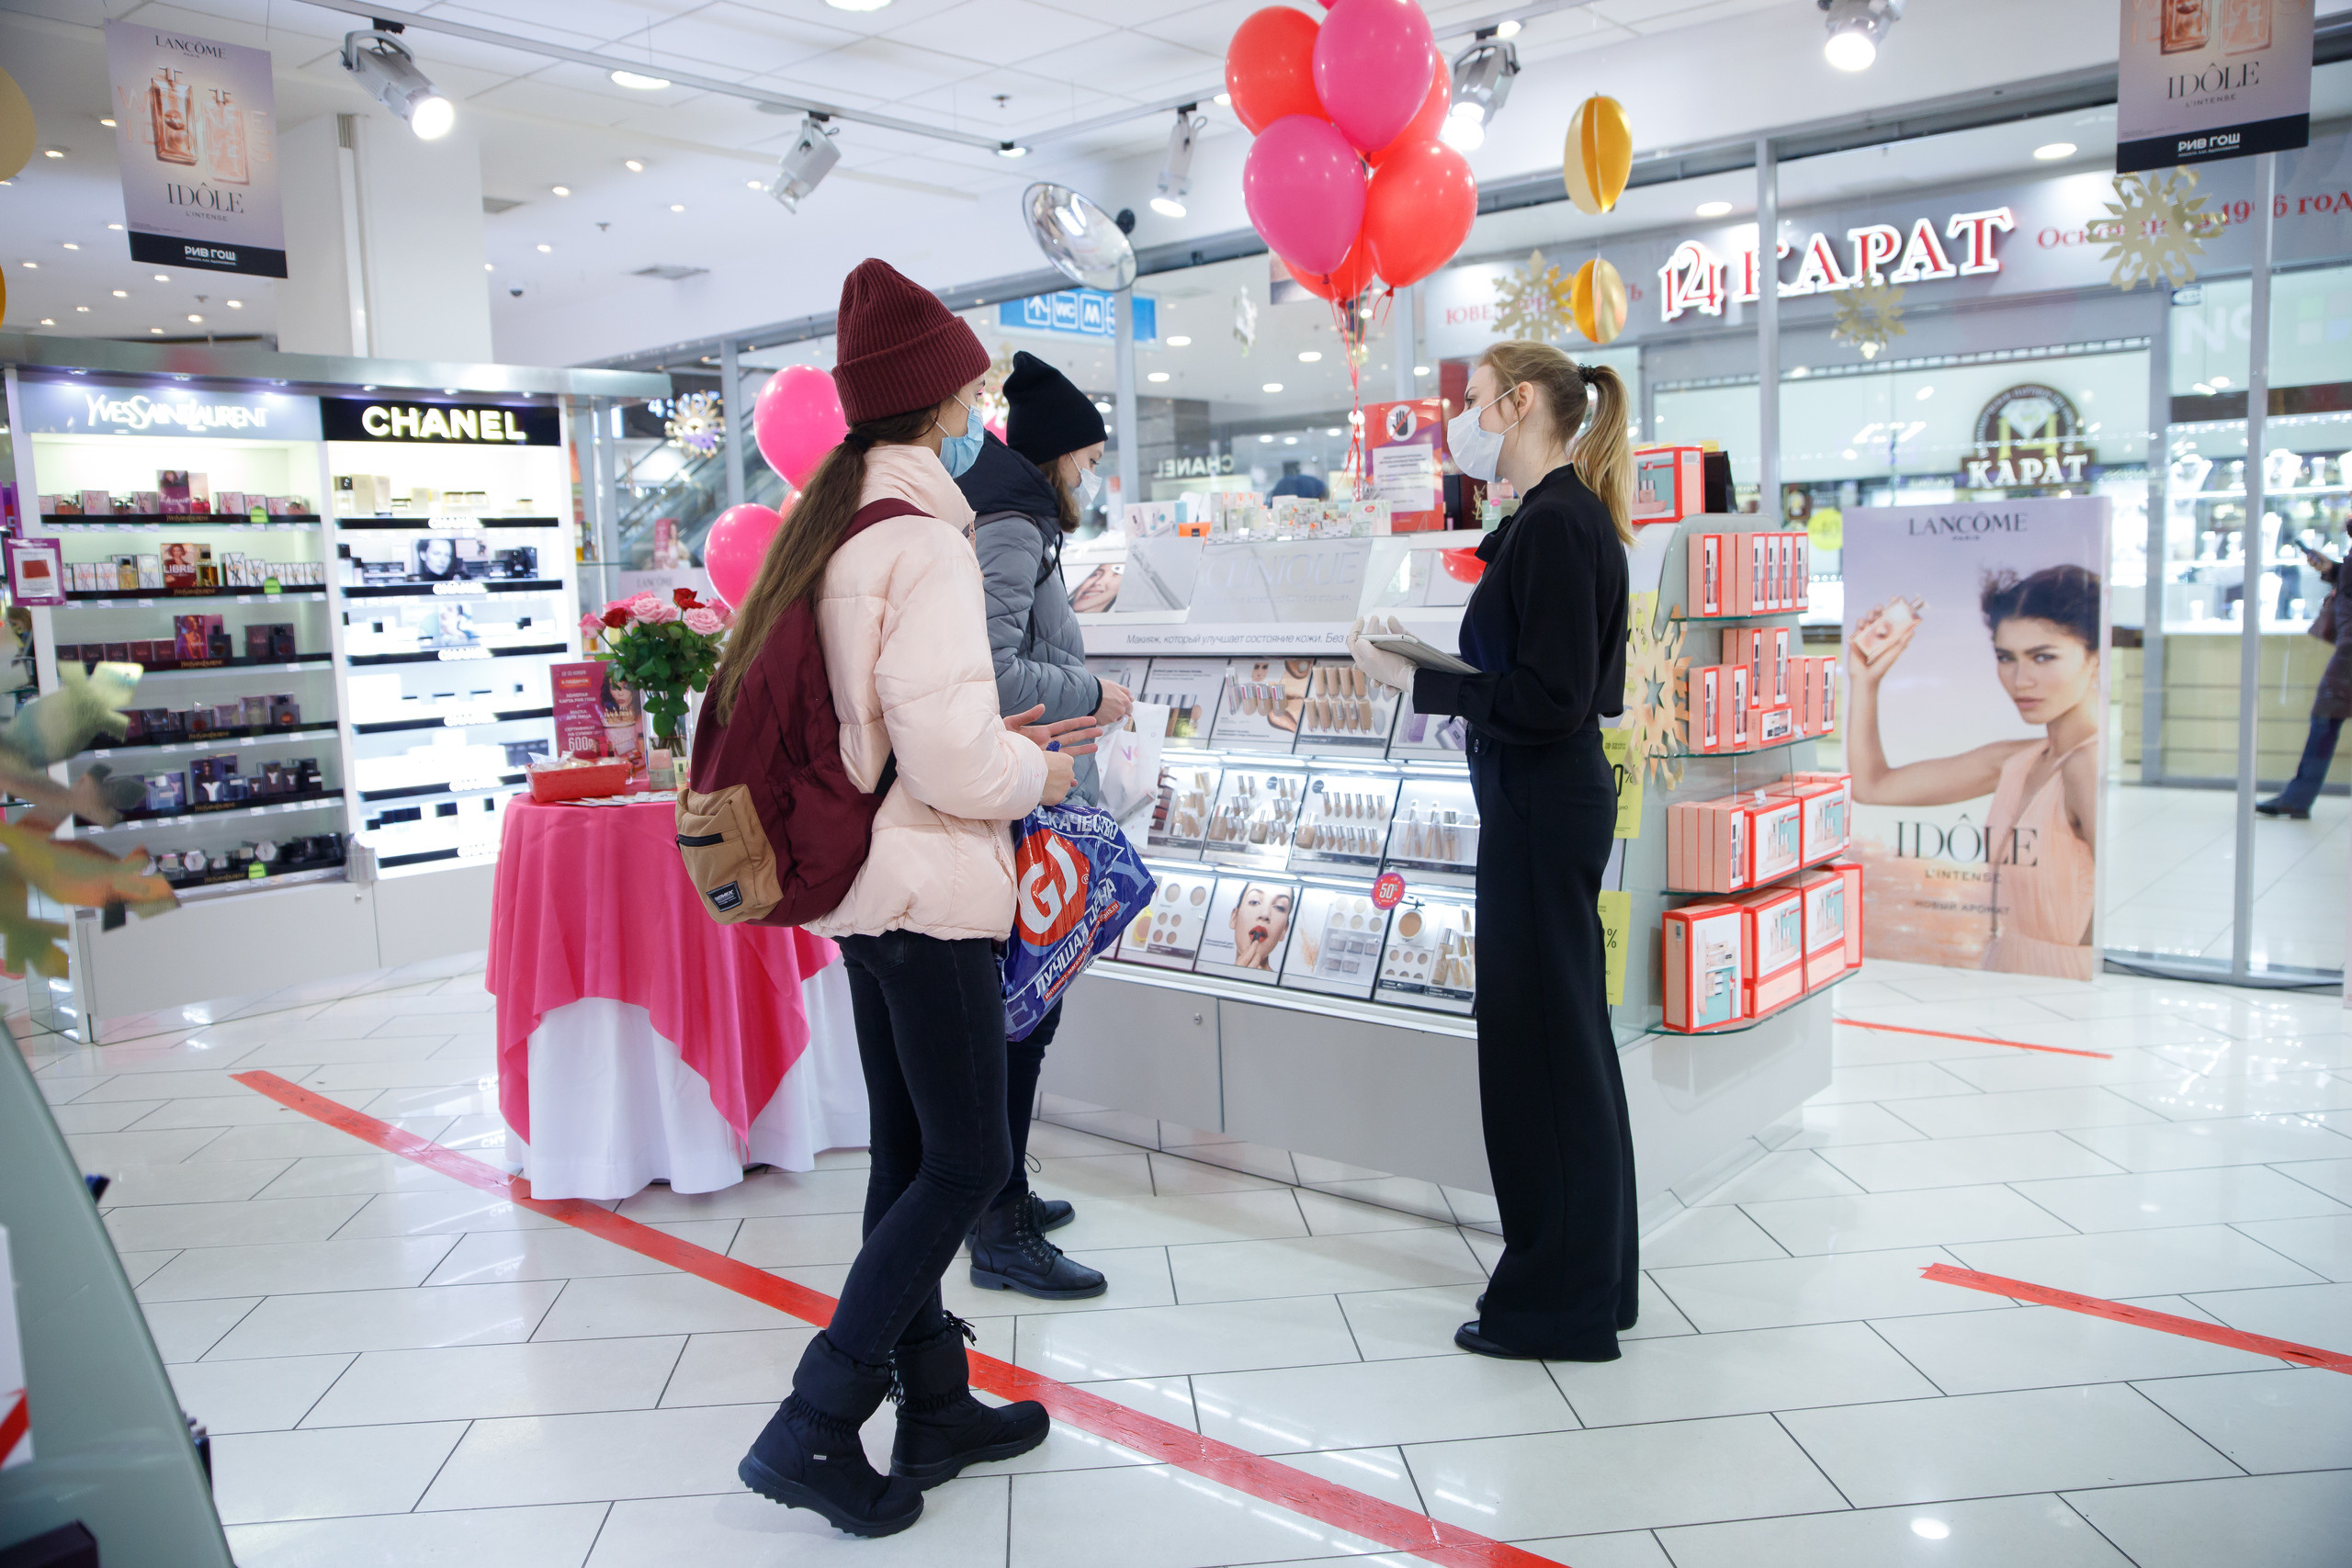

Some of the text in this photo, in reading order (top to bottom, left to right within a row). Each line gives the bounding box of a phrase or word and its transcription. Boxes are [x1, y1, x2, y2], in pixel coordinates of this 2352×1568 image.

[155, 36, 227, 59] LANCÔME
[2167, 62, 2260, 100] IDÔLE
[2185, 94, 2237, 107] L'INTENSE
[2178, 138, 2207, 152] РИВ
[2210, 132, 2241, 147] ГОШ
[166, 182, 244, 214] IDÔLE
[186, 210, 228, 221] L'INTENSE
[185, 245, 209, 258] РИВ
[210, 249, 237, 262] ГОШ
[1732, 206, 2016, 303] КАРАТ
[361, 406, 526, 440] CHANEL
[1967, 454, 2088, 489] КАРАТ
[1909, 512, 2028, 536] LANCÔME
[163, 565, 195, 574] LIBRE
[1206, 551, 1361, 590] CLINIQUE
[1126, 634, 1162, 645] Макияж,
[1164, 634, 1199, 645] который
[1202, 634, 1244, 645] улучшает
[1246, 633, 1294, 644] состояние
[1295, 633, 1323, 644] кожи.
[1325, 633, 1344, 643] Без
[202, 782, 224, 802] Y
[1896, 813, 2038, 867] IDÔLE
[1925, 869, 2002, 885] L'INTENSE
[1035, 920, 1090, 998] ЛУЧШАЯ
